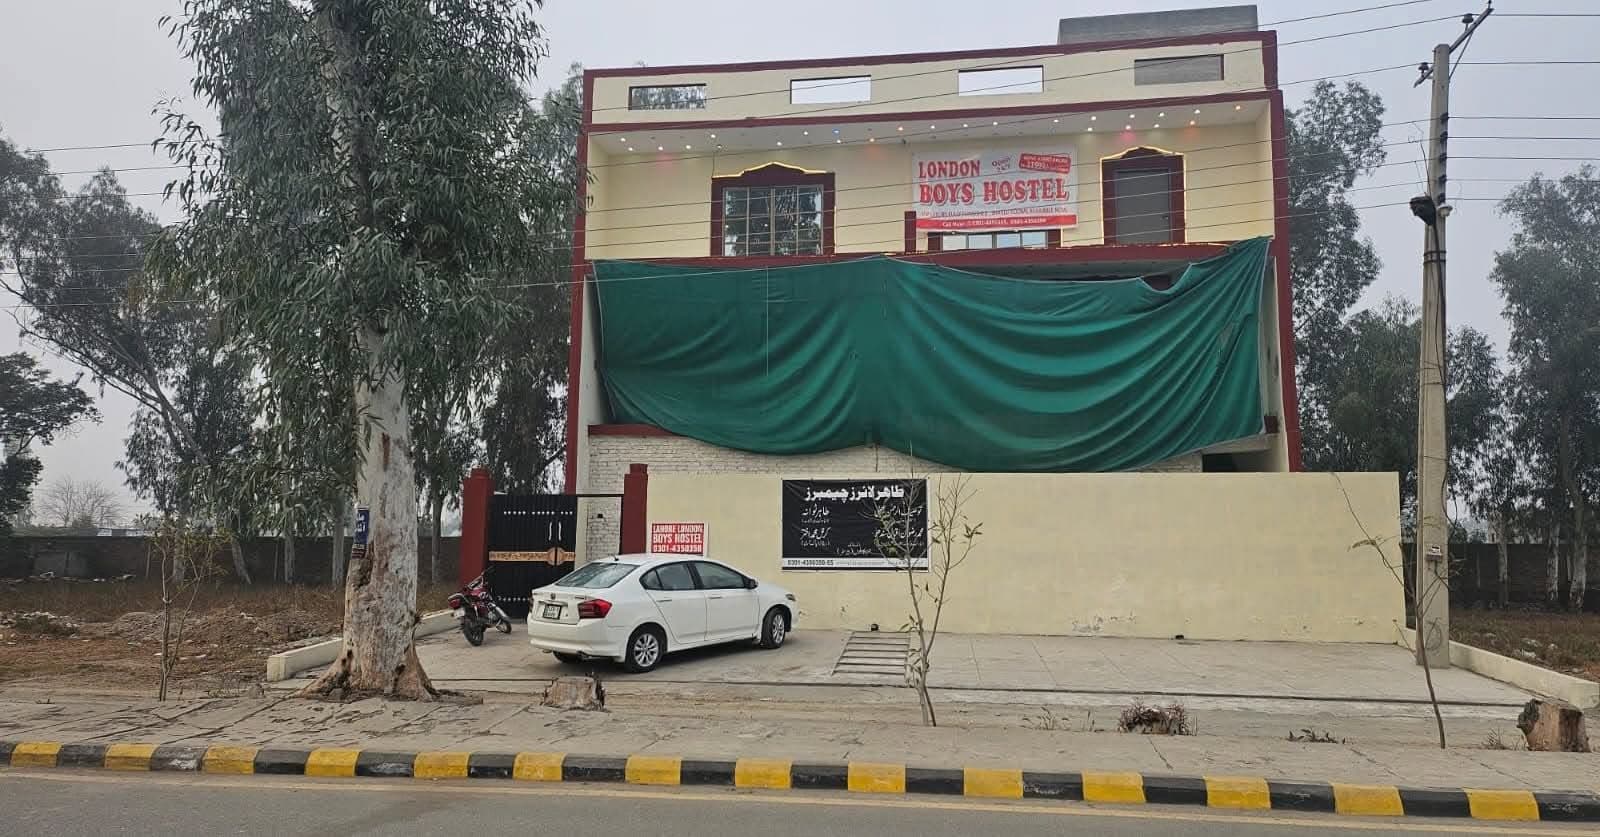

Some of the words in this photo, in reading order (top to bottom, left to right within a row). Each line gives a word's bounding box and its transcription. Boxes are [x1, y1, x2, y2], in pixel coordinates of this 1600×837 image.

[918, 159, 981, 179] LONDON
[919, 182, 975, 206] BOYS
[983, 178, 1070, 205] HOSTEL
[653, 524, 676, 534] LAHORE
[653, 533, 673, 544] BOYS
[675, 533, 703, 545] HOSTEL
